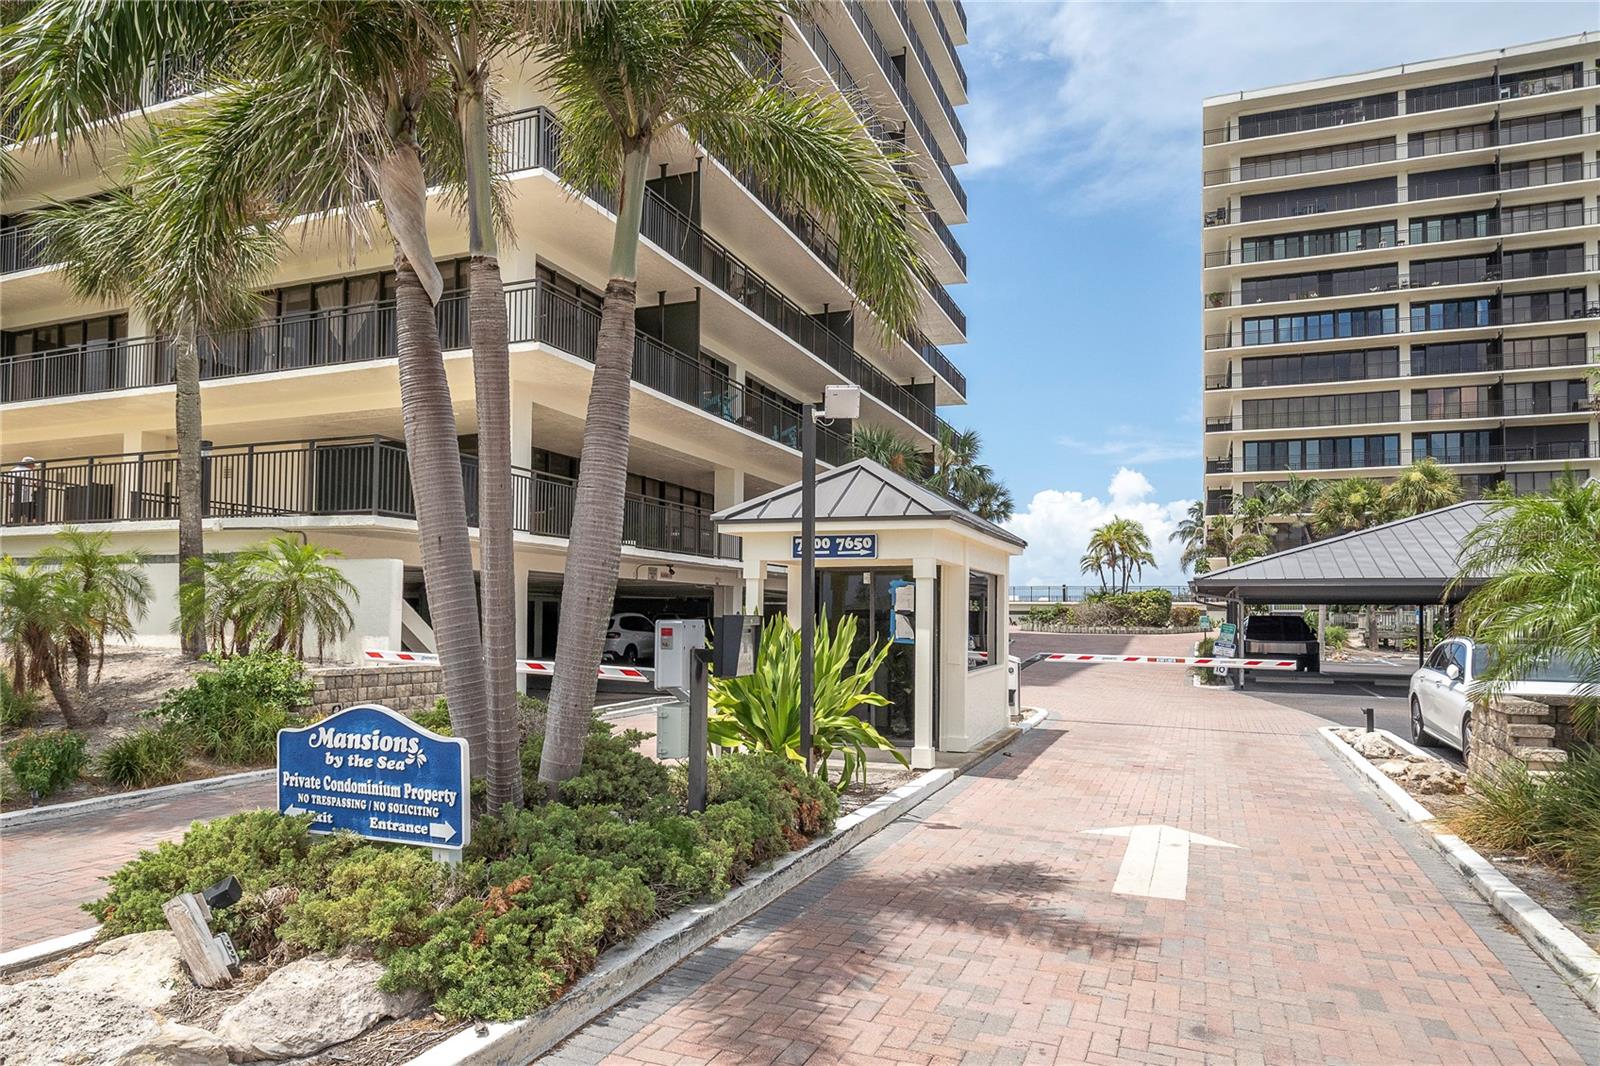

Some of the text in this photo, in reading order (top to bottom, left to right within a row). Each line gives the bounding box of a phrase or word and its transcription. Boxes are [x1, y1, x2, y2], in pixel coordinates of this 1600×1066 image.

[795, 537, 872, 551] 700 7650
[308, 727, 420, 754] Mansions
[325, 752, 406, 771] by the Sea
[282, 771, 457, 807] Private Condominium Property
[297, 793, 310, 803] NO
[311, 795, 367, 810] TRESPASSING
[373, 801, 387, 812] NO
[388, 803, 440, 818] SOLICITING
[369, 816, 429, 835] Entrance
